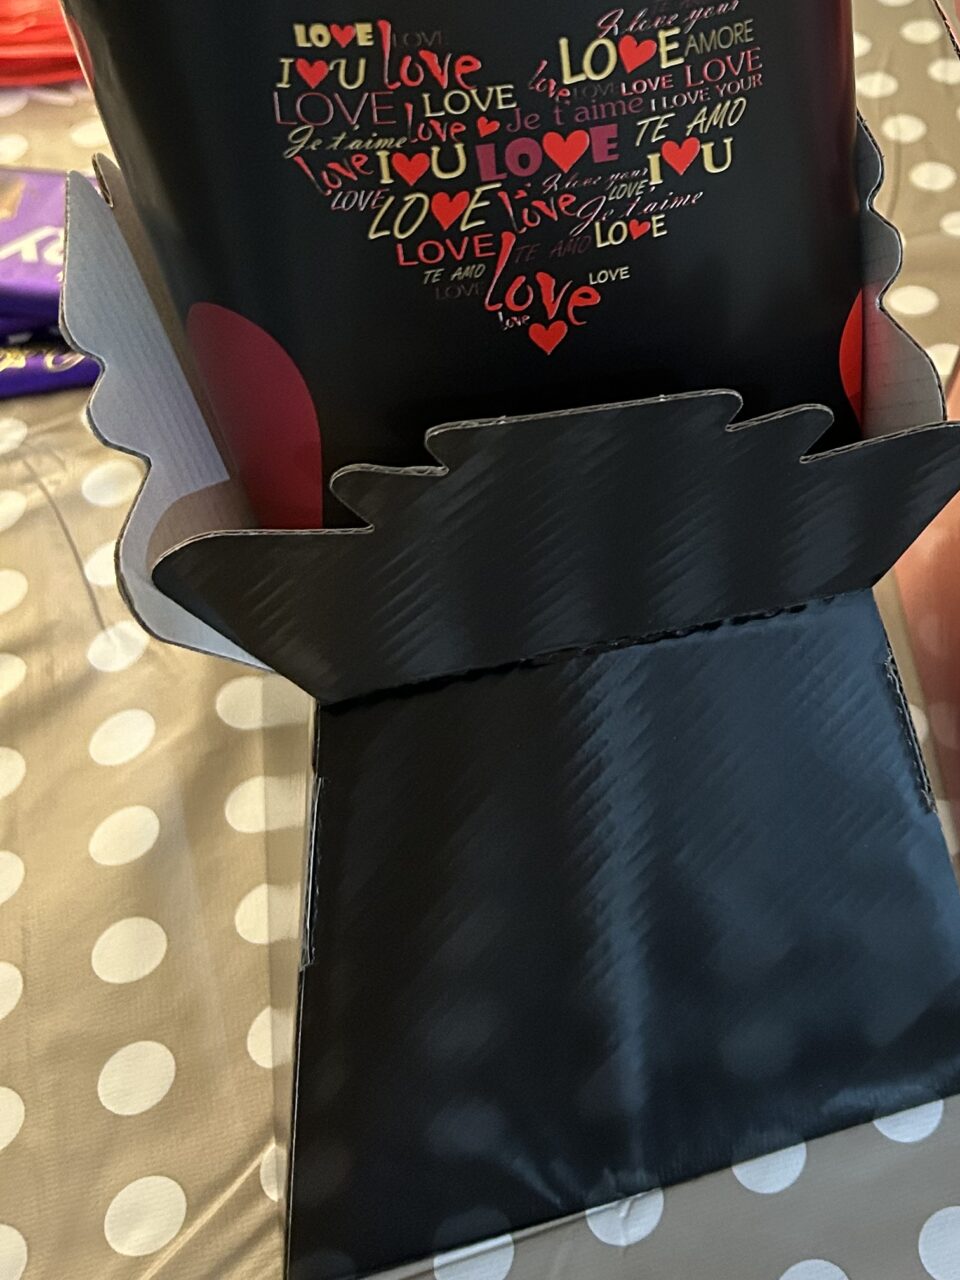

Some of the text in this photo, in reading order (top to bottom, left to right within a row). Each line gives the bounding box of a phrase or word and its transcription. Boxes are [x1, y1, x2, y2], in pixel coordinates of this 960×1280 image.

[684, 18, 756, 56] AMORE
[684, 46, 763, 88] LOVE
[422, 84, 518, 118] LOVE
[620, 73, 675, 97] LOVE
[660, 86, 711, 110] LOVE
[715, 73, 764, 98] YOUR
[272, 90, 398, 126] LOVE
[634, 96, 748, 148] TE AMO
[331, 187, 387, 213] LOVE
[396, 232, 498, 267] LOVE
[422, 263, 486, 285] TE AMO
[588, 265, 631, 286] LOVE
